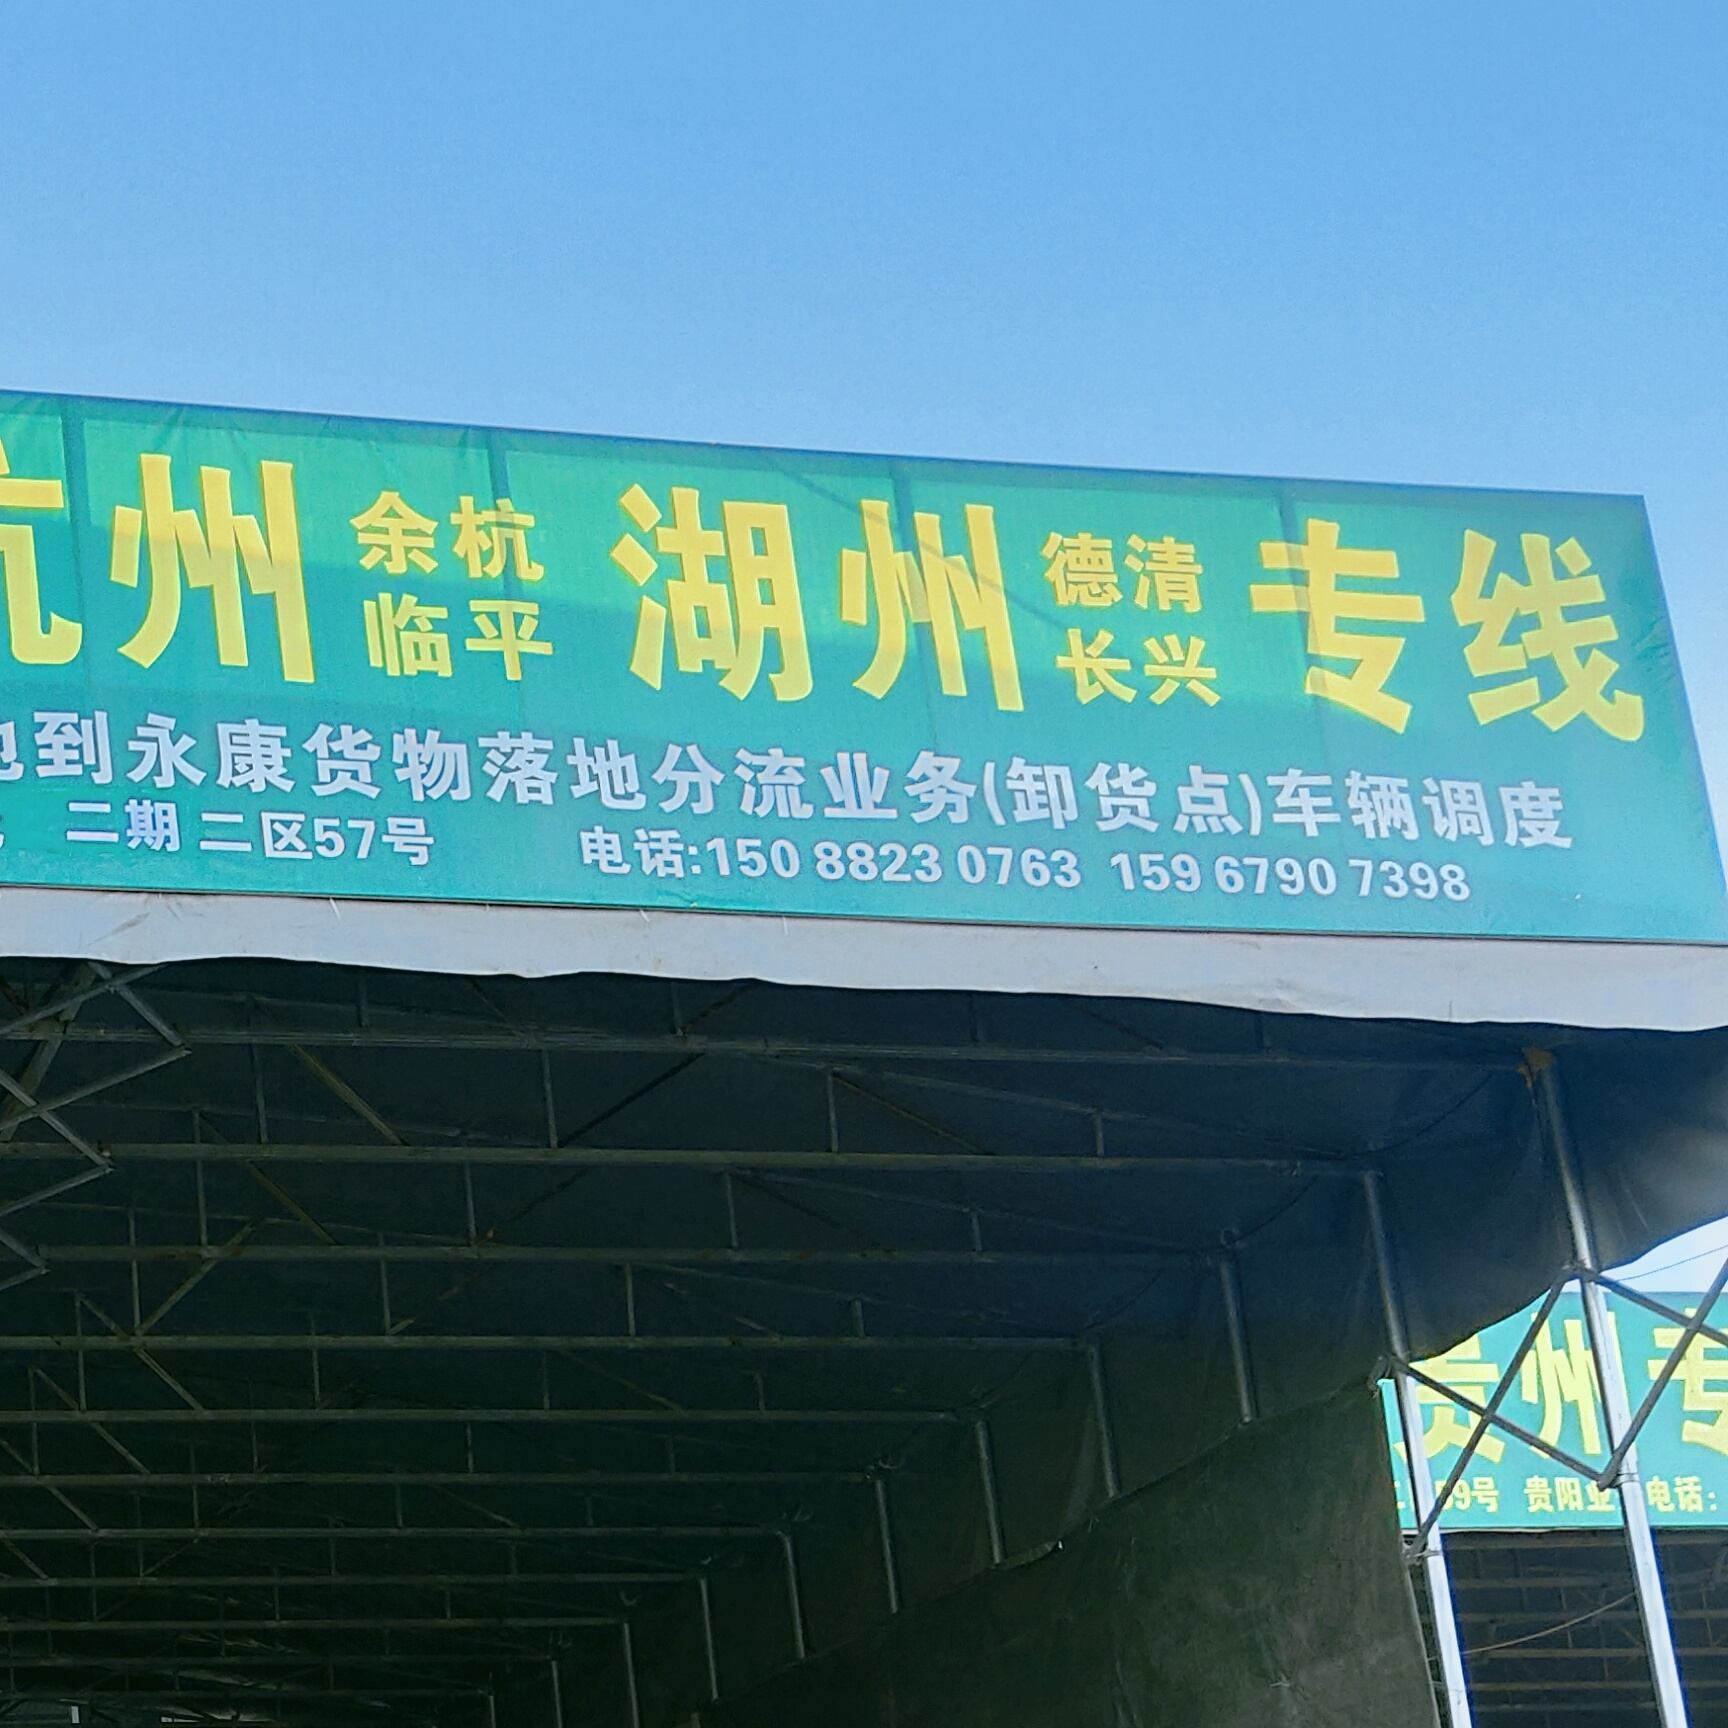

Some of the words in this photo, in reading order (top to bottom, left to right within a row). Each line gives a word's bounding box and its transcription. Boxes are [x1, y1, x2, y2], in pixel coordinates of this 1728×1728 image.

[349, 490, 545, 582] 余杭
[1040, 531, 1204, 614] 德清
[363, 592, 554, 681] 临平
[610, 483, 1024, 713] 湖州
[1250, 518, 1646, 742] 专线
[1056, 628, 1222, 708] 长兴
[815, 840, 941, 883] 8823
[957, 845, 1082, 888] 0763
[1110, 851, 1202, 892] 159
[1215, 854, 1337, 896] 6790
[1357, 859, 1470, 902] 7398
